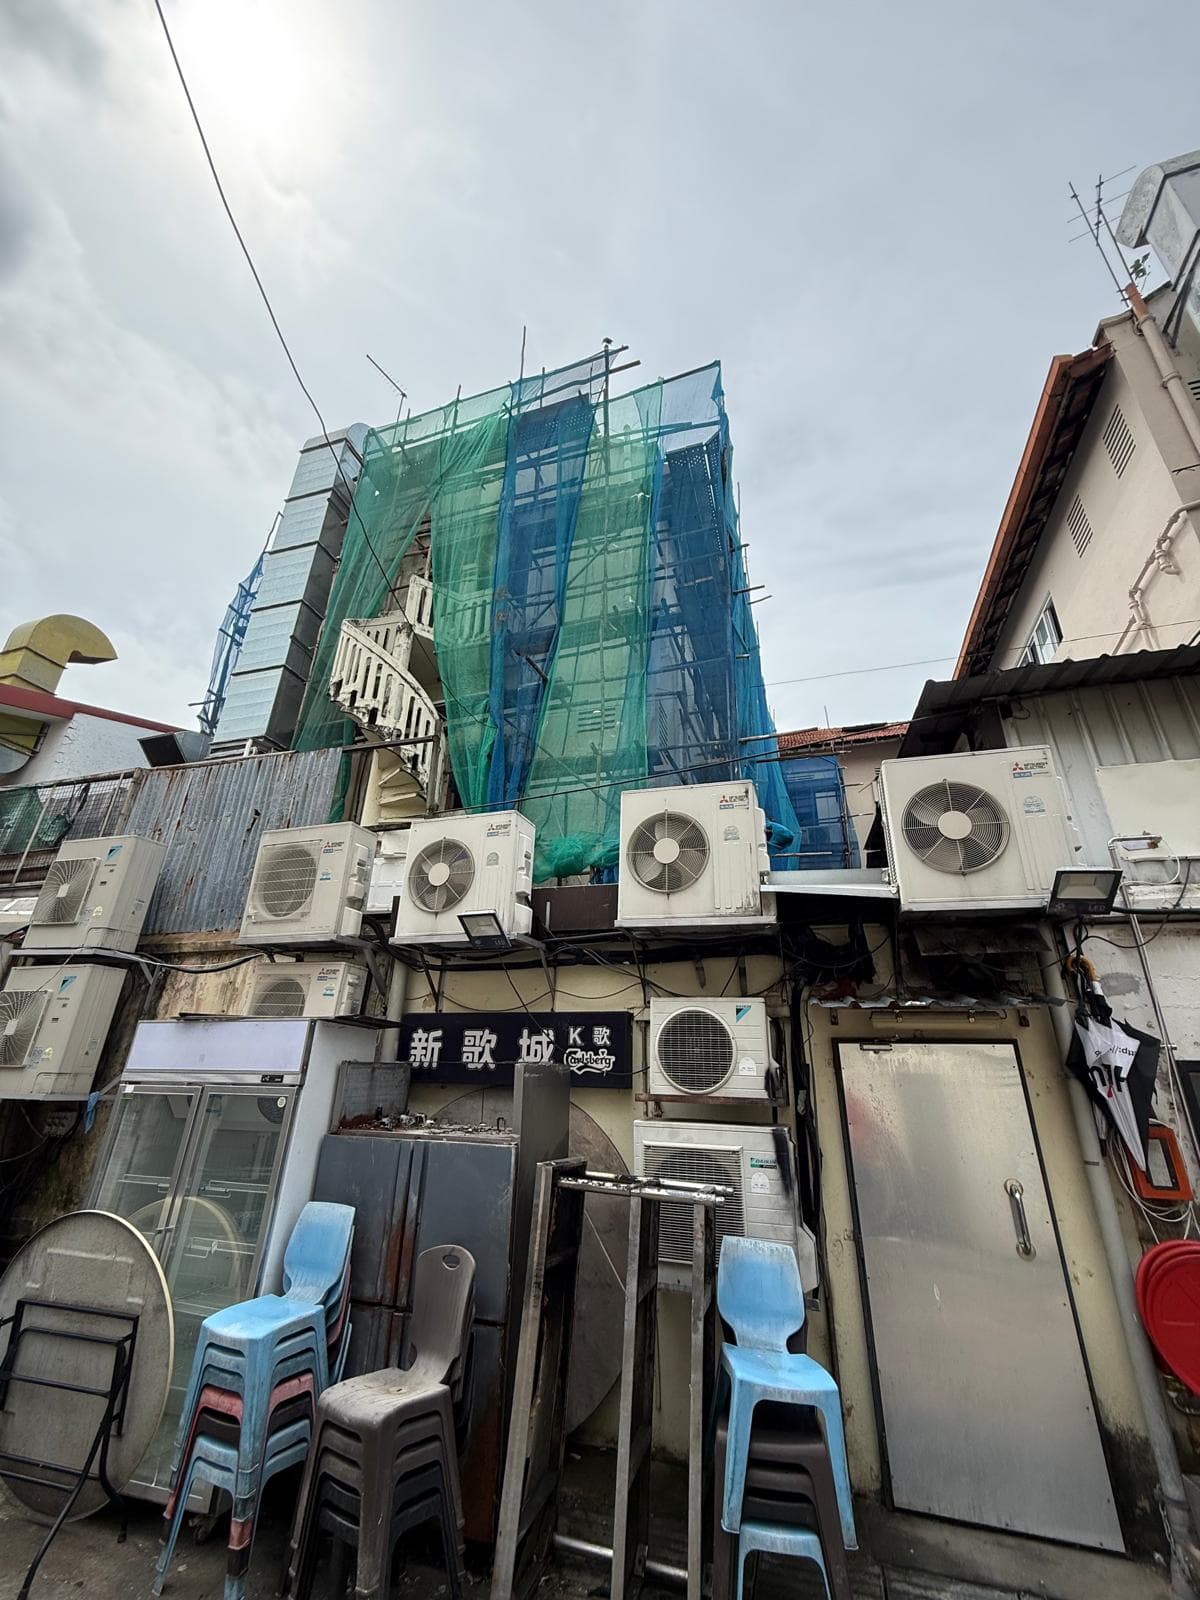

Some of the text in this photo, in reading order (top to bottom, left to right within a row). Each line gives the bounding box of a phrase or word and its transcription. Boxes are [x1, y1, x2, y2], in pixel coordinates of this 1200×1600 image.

[409, 1028, 554, 1070] 新歌城
[564, 1048, 615, 1071] Carlsberg
